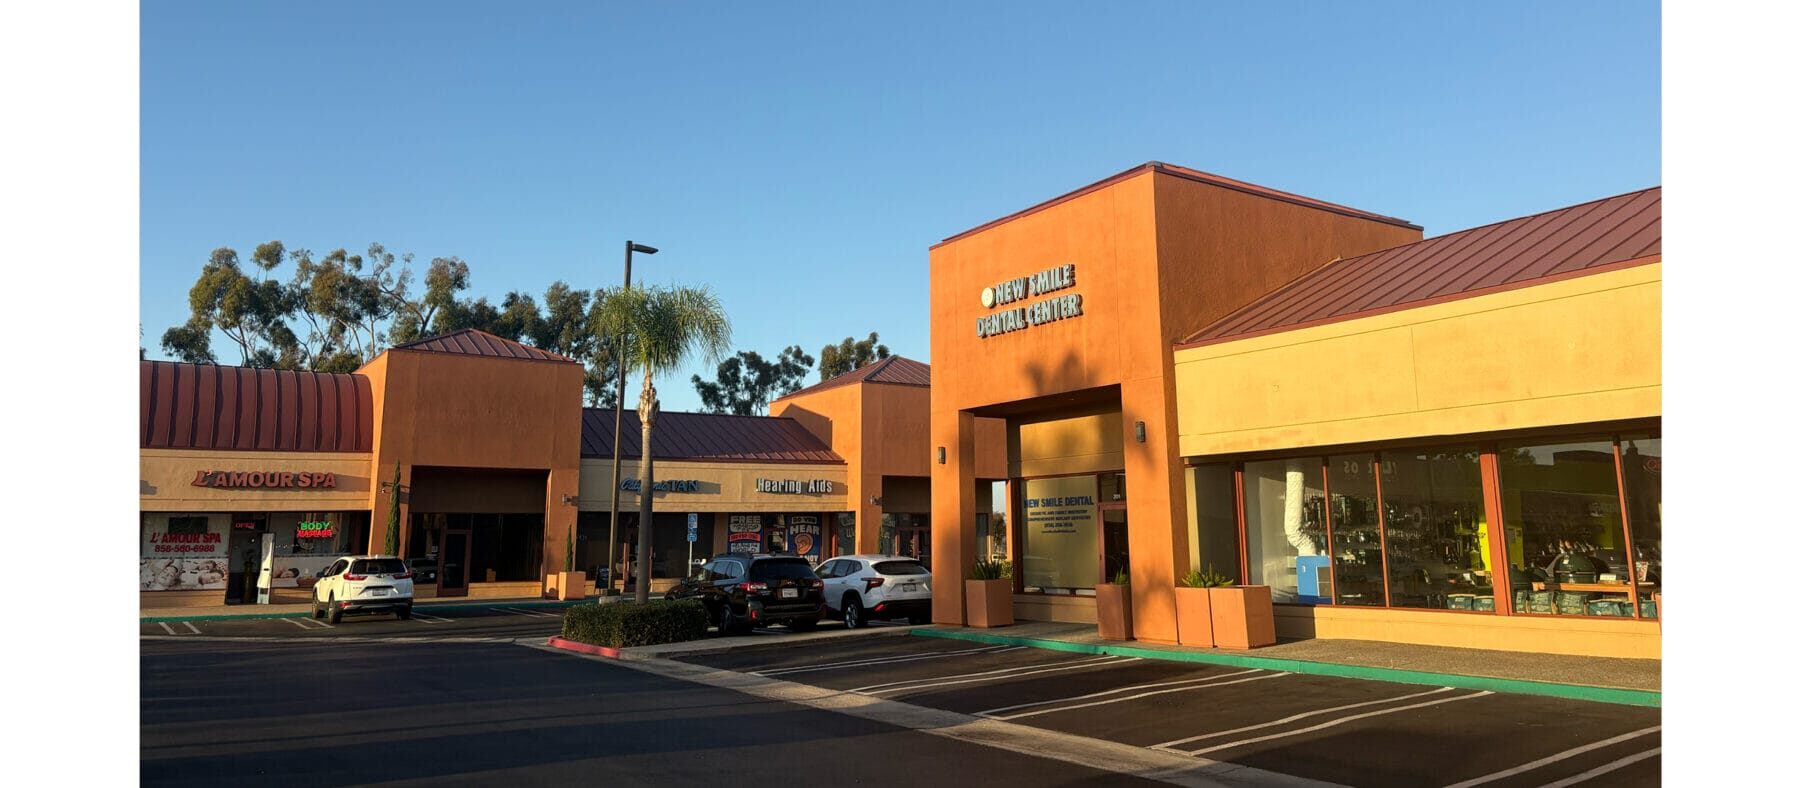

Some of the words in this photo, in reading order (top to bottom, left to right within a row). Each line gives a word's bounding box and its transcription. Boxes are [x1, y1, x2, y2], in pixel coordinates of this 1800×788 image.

[996, 279, 1027, 305] NEW
[1029, 264, 1073, 296] SMILE
[977, 309, 1027, 338] DENTAL
[1027, 294, 1082, 326] CENTER
[298, 472, 336, 488] SPA
[670, 480, 699, 492] TAN
[757, 479, 802, 494] Hearing
[808, 479, 832, 493] Aids
[1024, 498, 1039, 508] NEW
[1041, 498, 1063, 507] SMILE
[1065, 496, 1094, 506] DENTAL
[730, 515, 761, 524] FREE
[301, 522, 330, 530] BODY
[790, 525, 820, 535] HEAR
[203, 533, 222, 543] SPA
